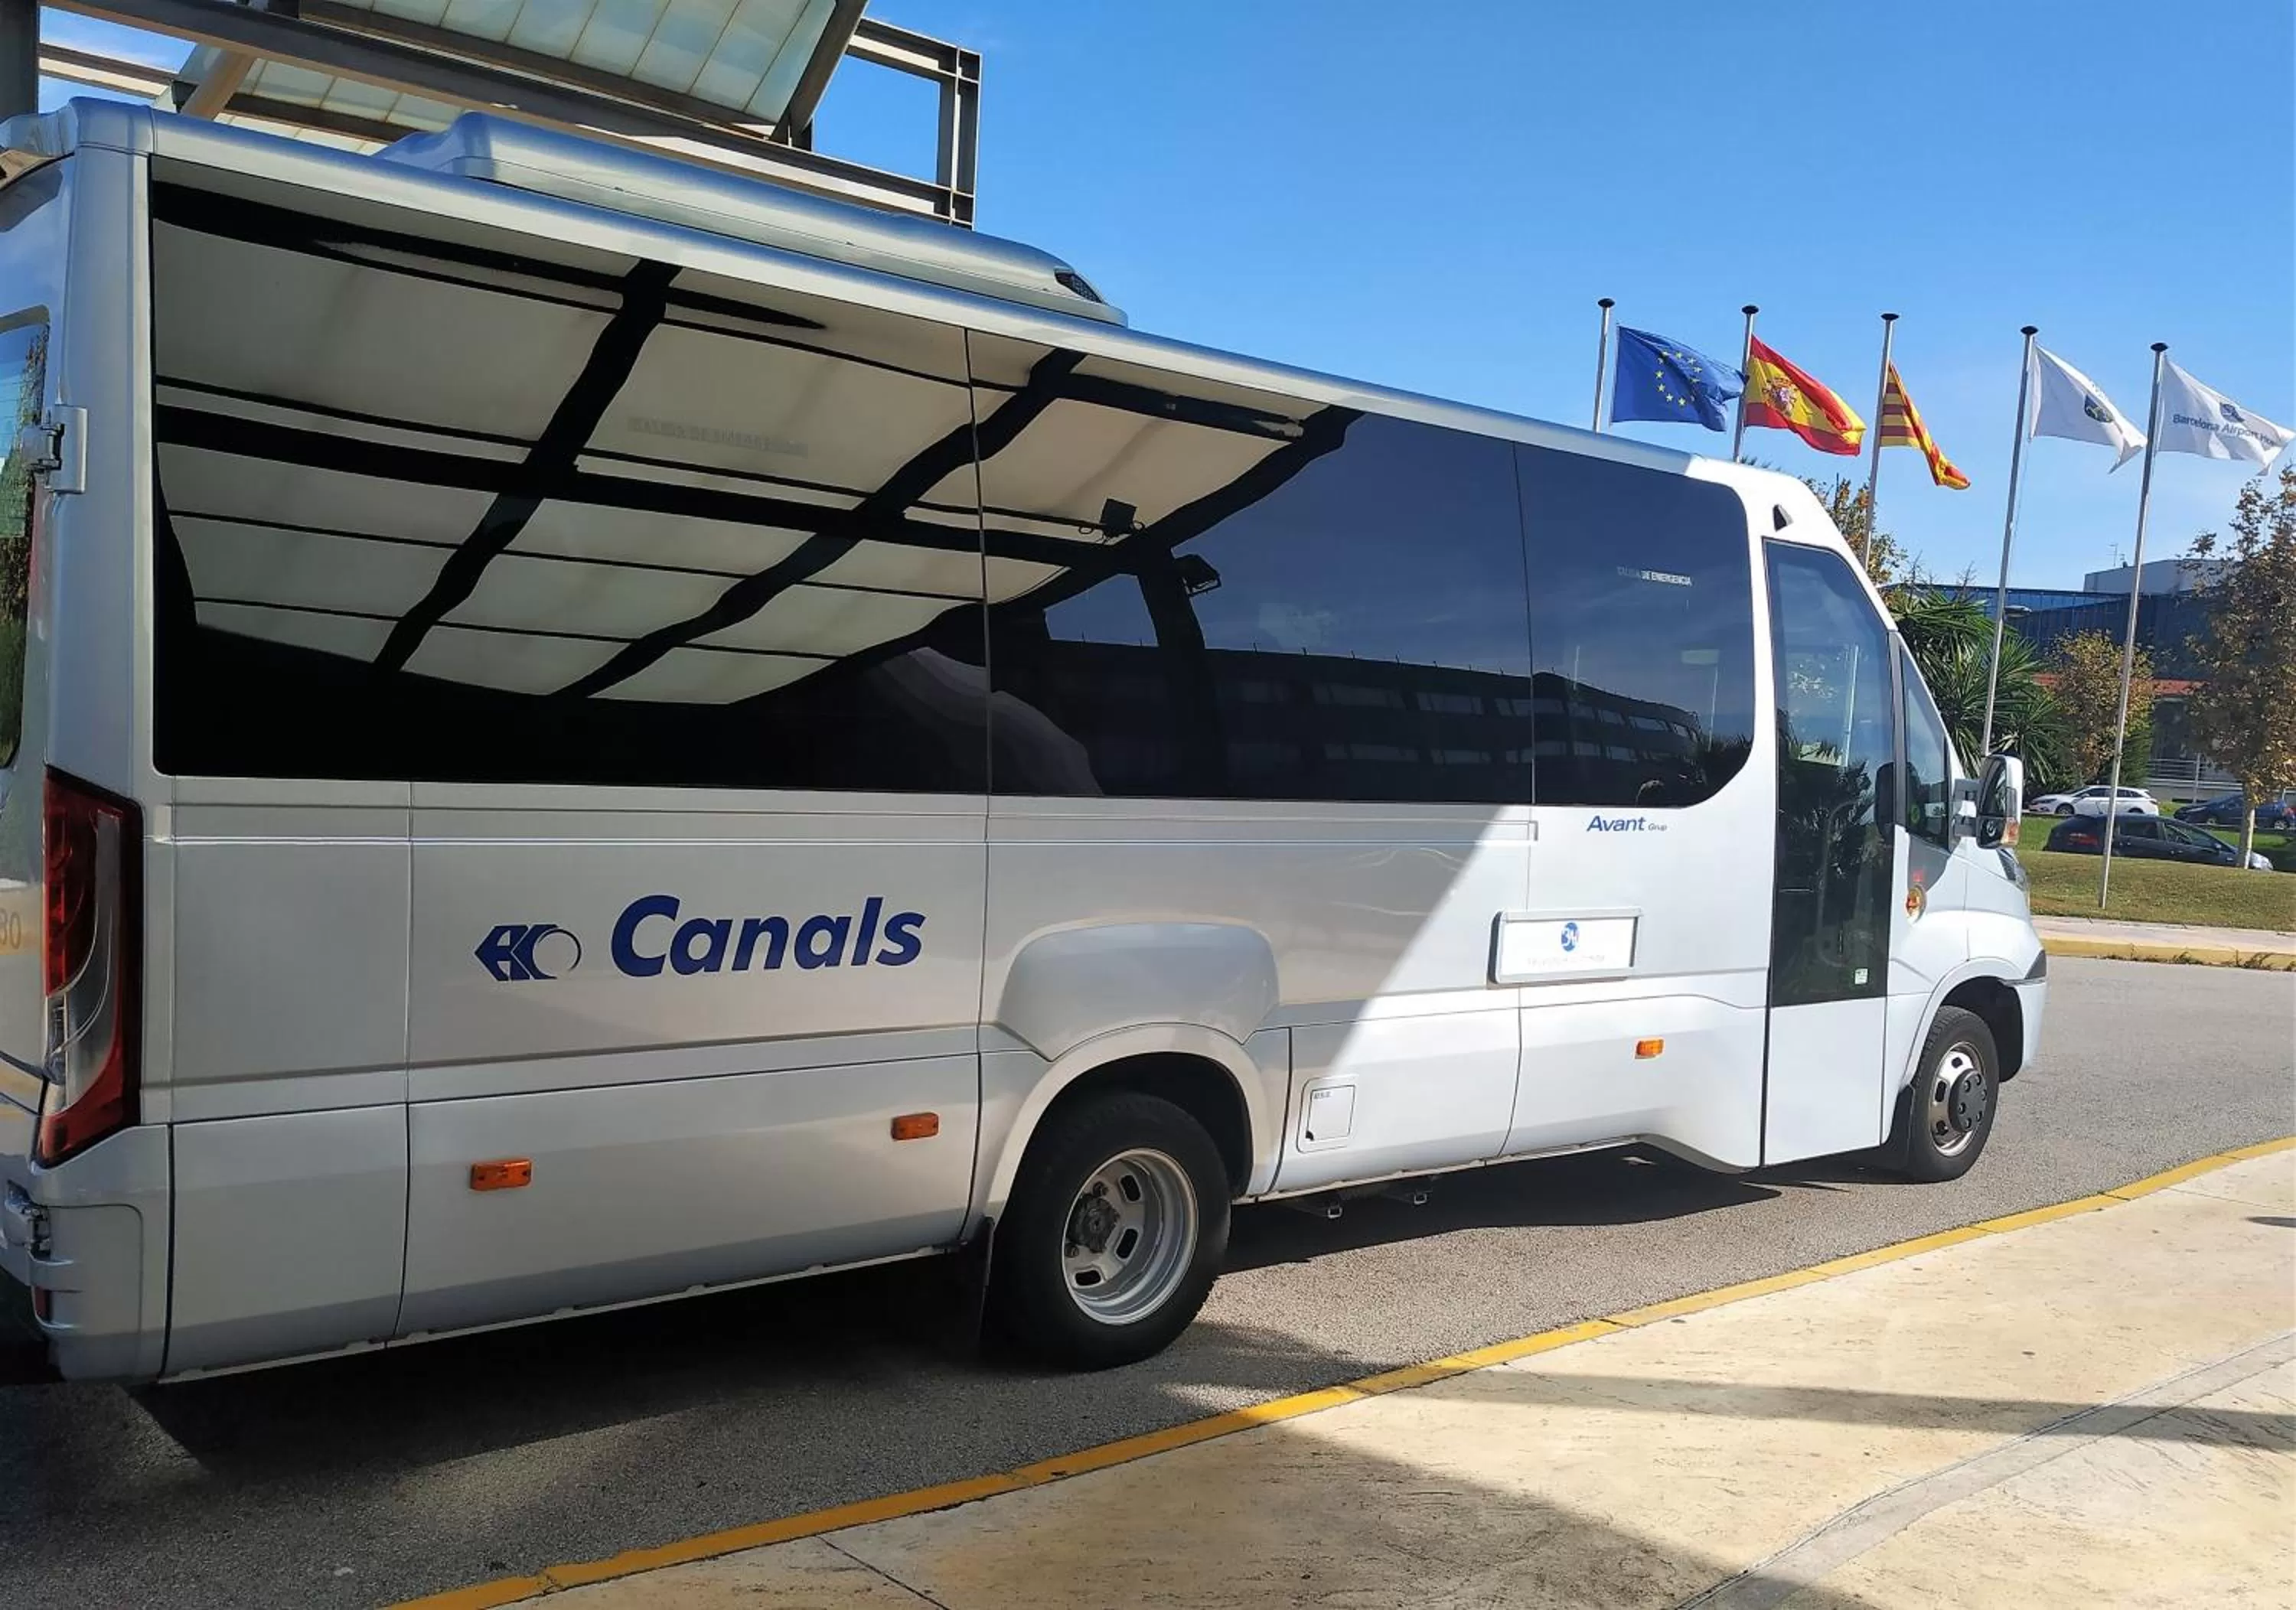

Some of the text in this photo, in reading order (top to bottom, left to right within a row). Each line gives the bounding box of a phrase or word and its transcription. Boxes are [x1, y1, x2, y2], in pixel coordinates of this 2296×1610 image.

[2172, 414, 2219, 432] Barcelona
[1587, 815, 1646, 832] Avant
[612, 894, 926, 977] Canals
